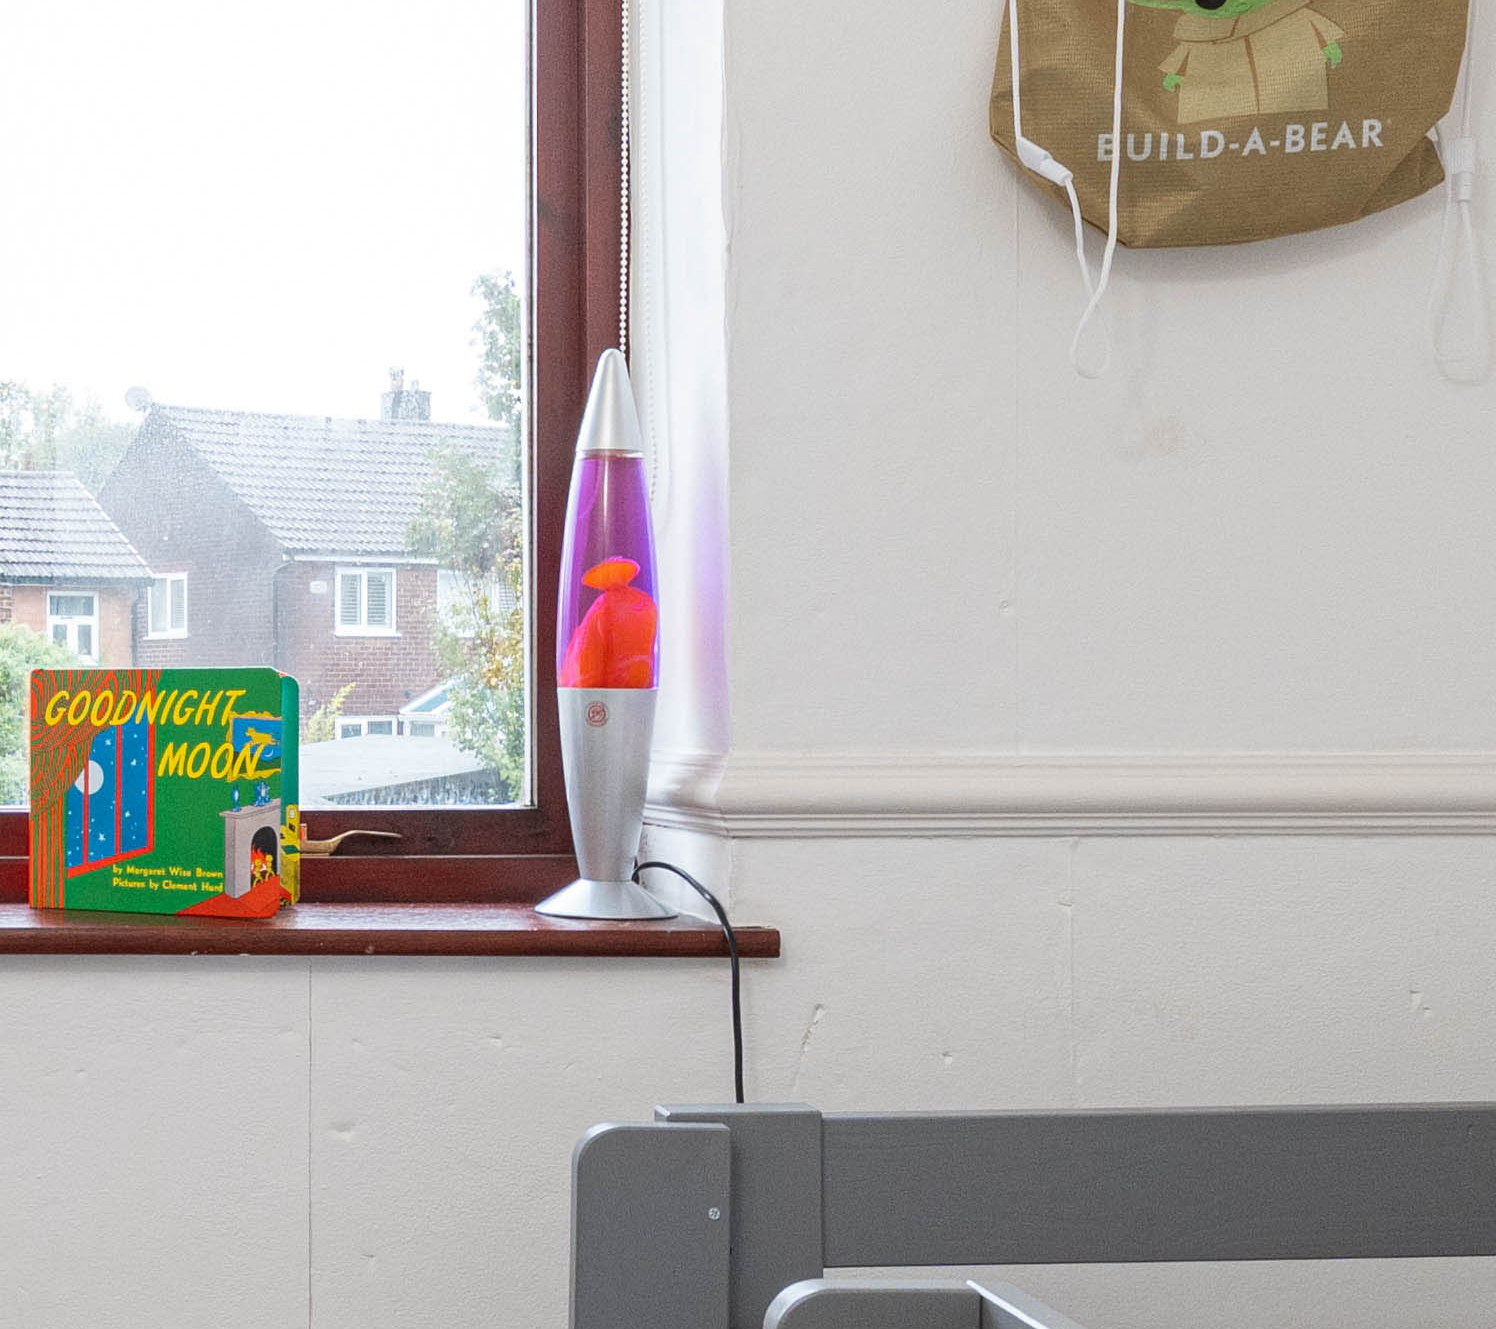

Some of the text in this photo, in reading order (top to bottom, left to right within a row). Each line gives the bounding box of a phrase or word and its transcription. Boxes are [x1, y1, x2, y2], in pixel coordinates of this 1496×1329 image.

[1097, 119, 1384, 162] BUILD-A-BEAR
[45, 689, 246, 727] GOODNIGHT
[158, 741, 265, 779] MOON
